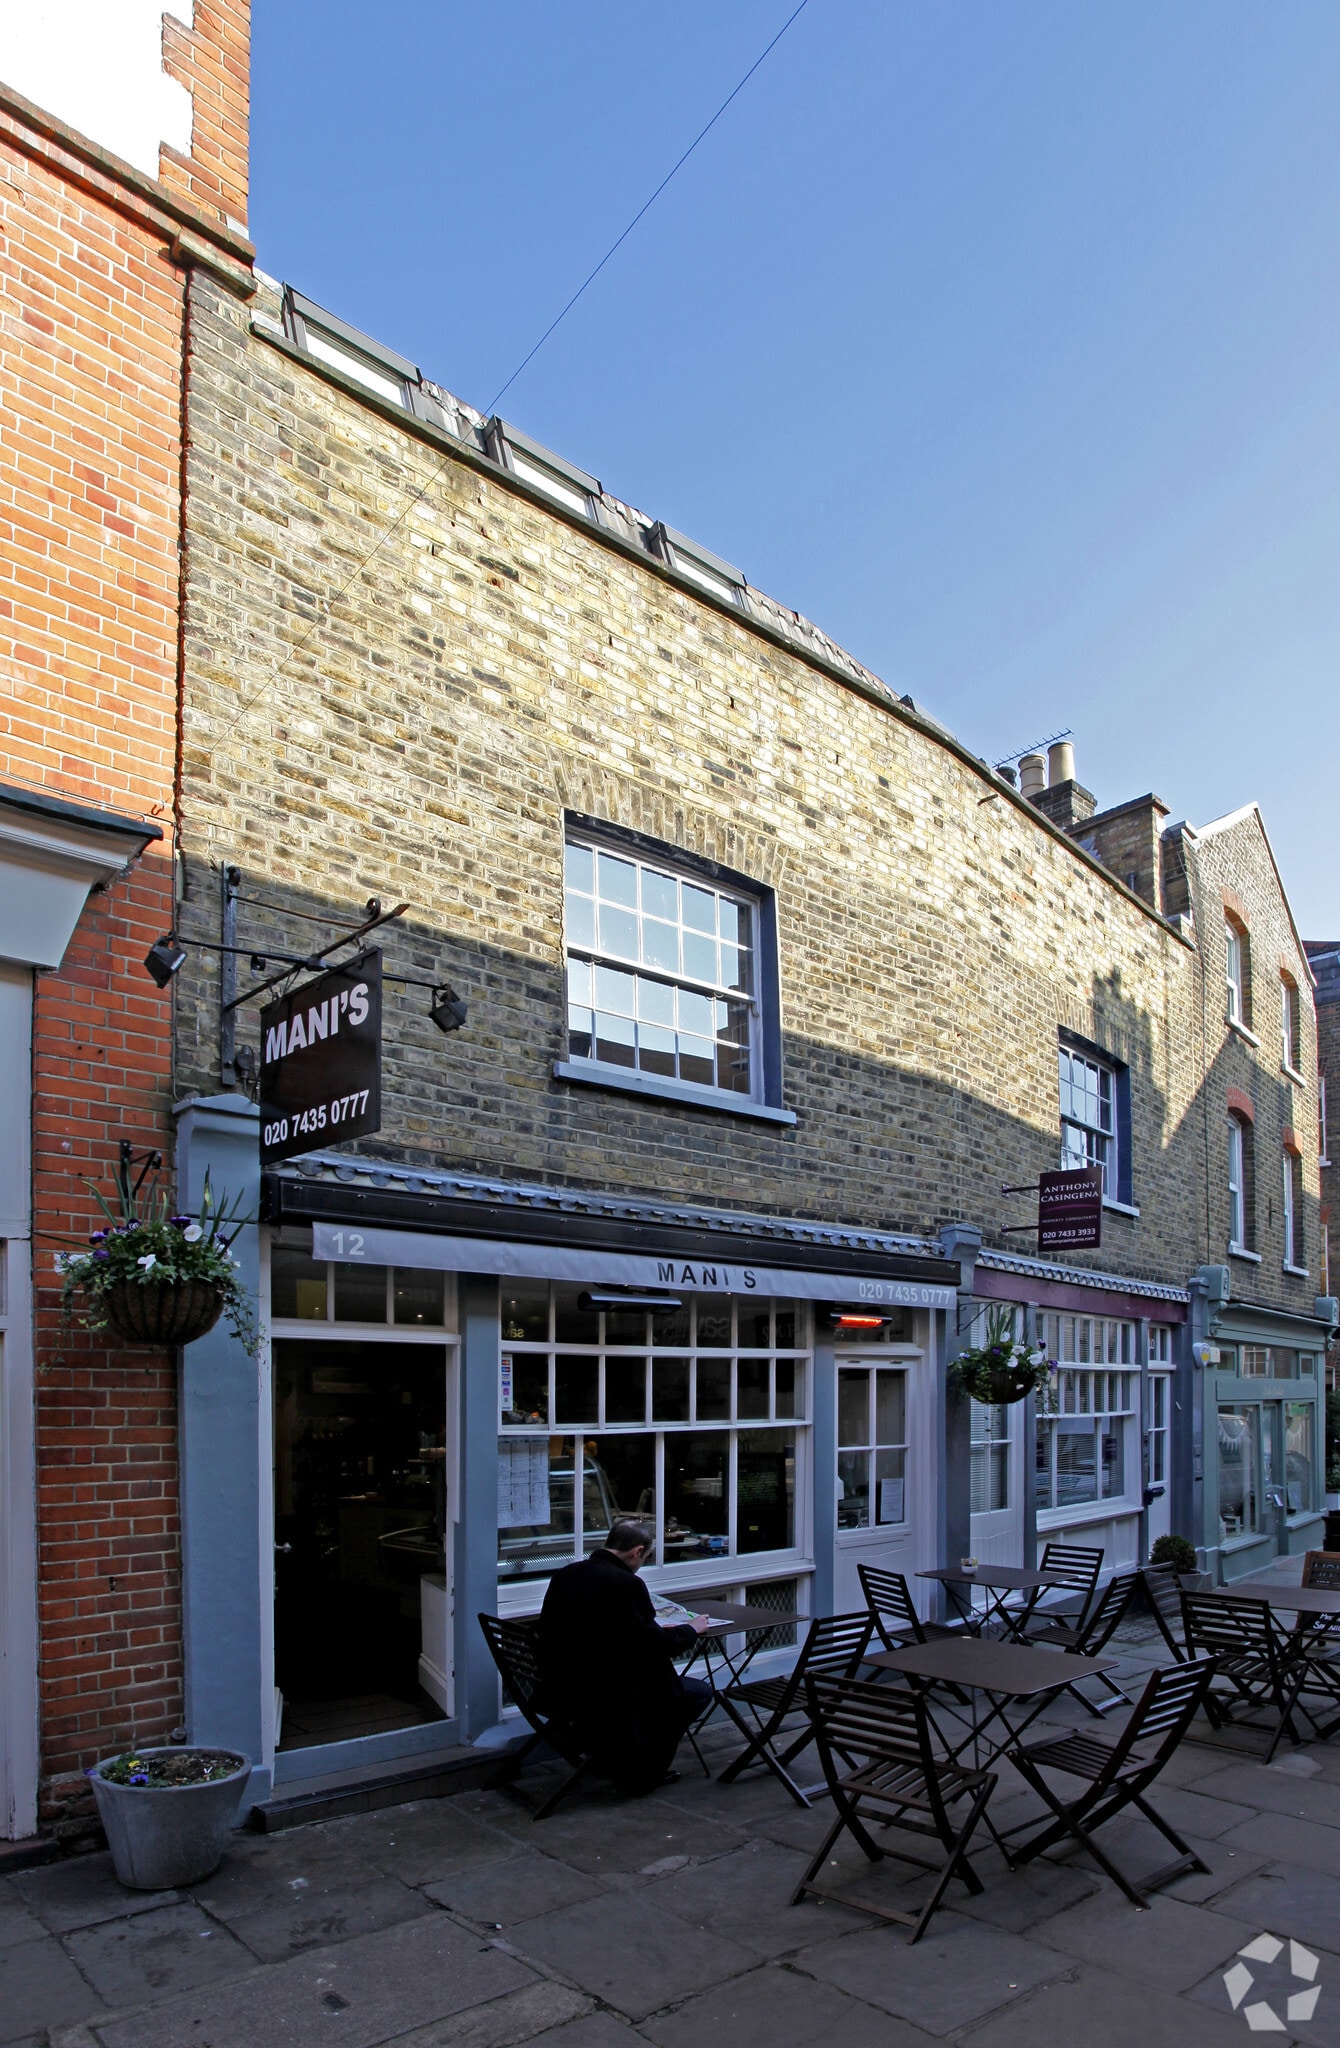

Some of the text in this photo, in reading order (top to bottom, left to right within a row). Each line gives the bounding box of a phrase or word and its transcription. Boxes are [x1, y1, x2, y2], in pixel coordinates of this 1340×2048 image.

[265, 982, 370, 1064] MANI'S
[264, 1089, 370, 1146] 020 7435 0777
[1041, 1191, 1099, 1202] CASINGENA
[1044, 1182, 1096, 1193] ANTHONY
[332, 1231, 365, 1256] 12
[1042, 1227, 1096, 1239] 020 7433 3933
[657, 1262, 757, 1289] MANI'S
[858, 1282, 951, 1305] 020 7435 0777
